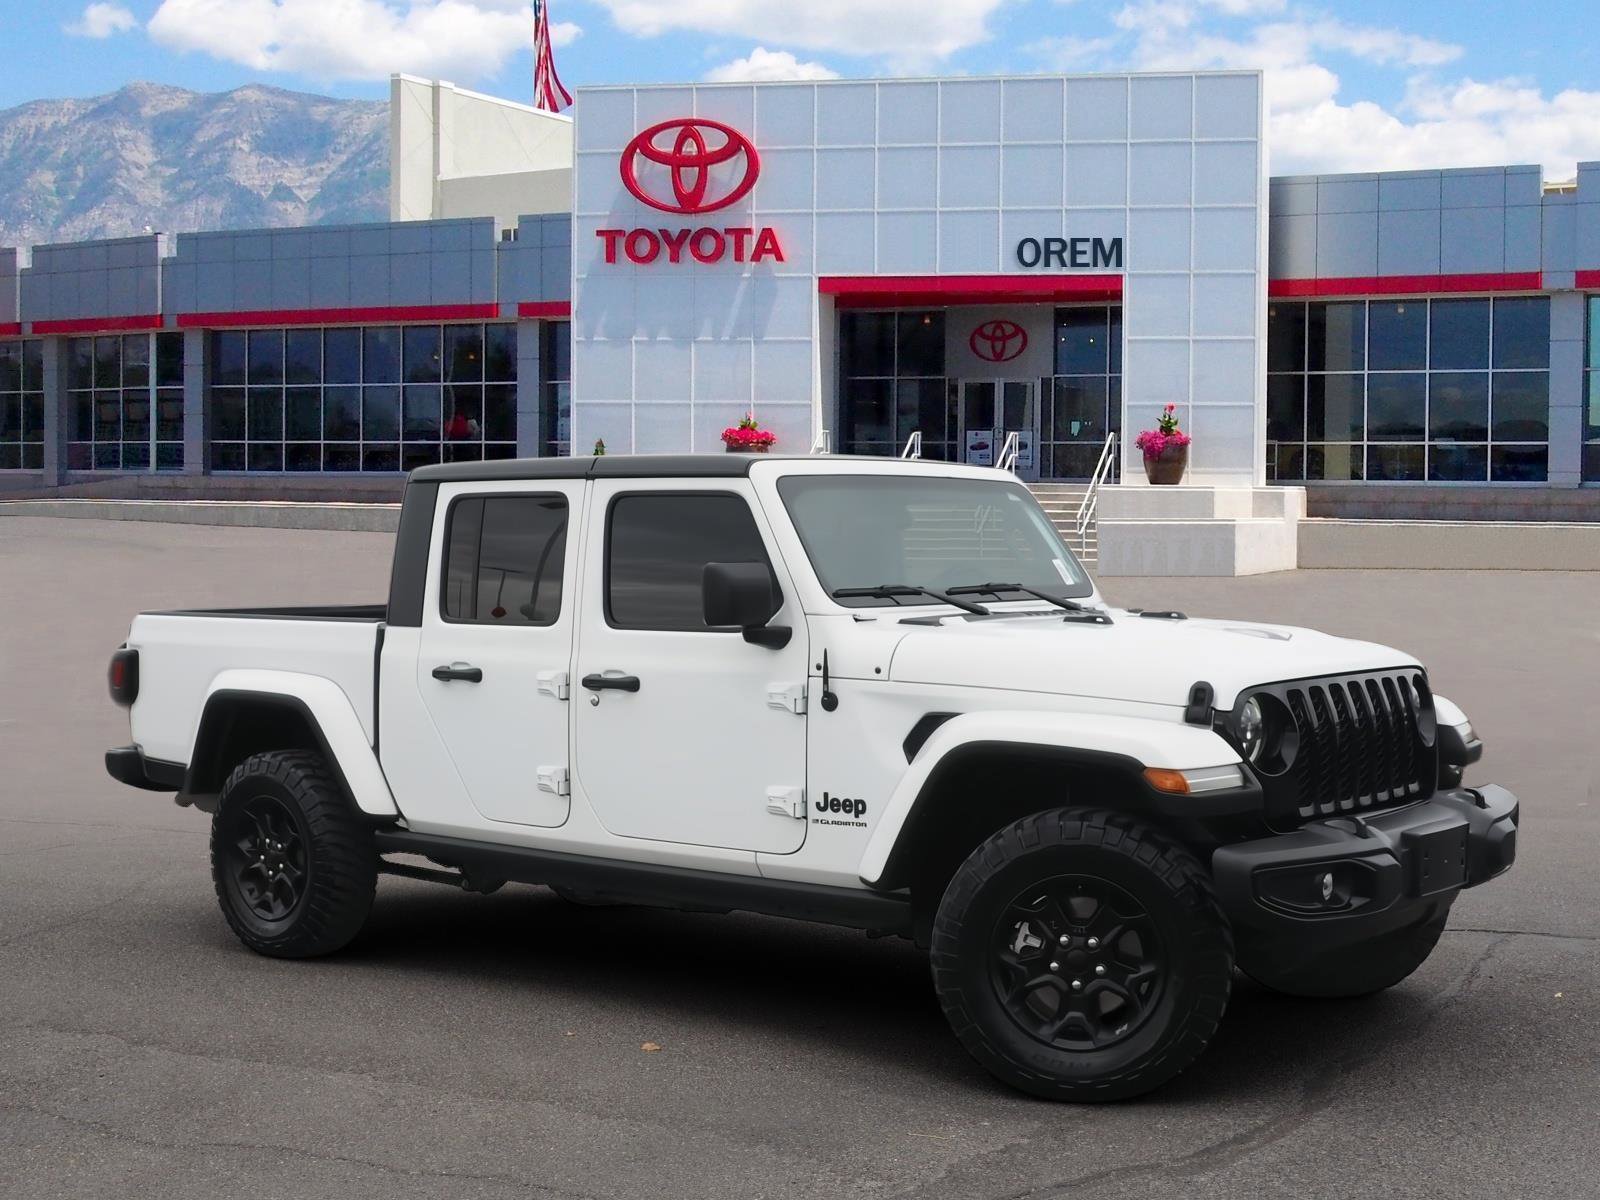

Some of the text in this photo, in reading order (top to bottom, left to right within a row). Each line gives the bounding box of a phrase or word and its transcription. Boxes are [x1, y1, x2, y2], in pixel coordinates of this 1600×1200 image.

[596, 227, 784, 264] TOYOTA
[1017, 237, 1122, 268] OREM
[815, 791, 867, 818] Jeep
